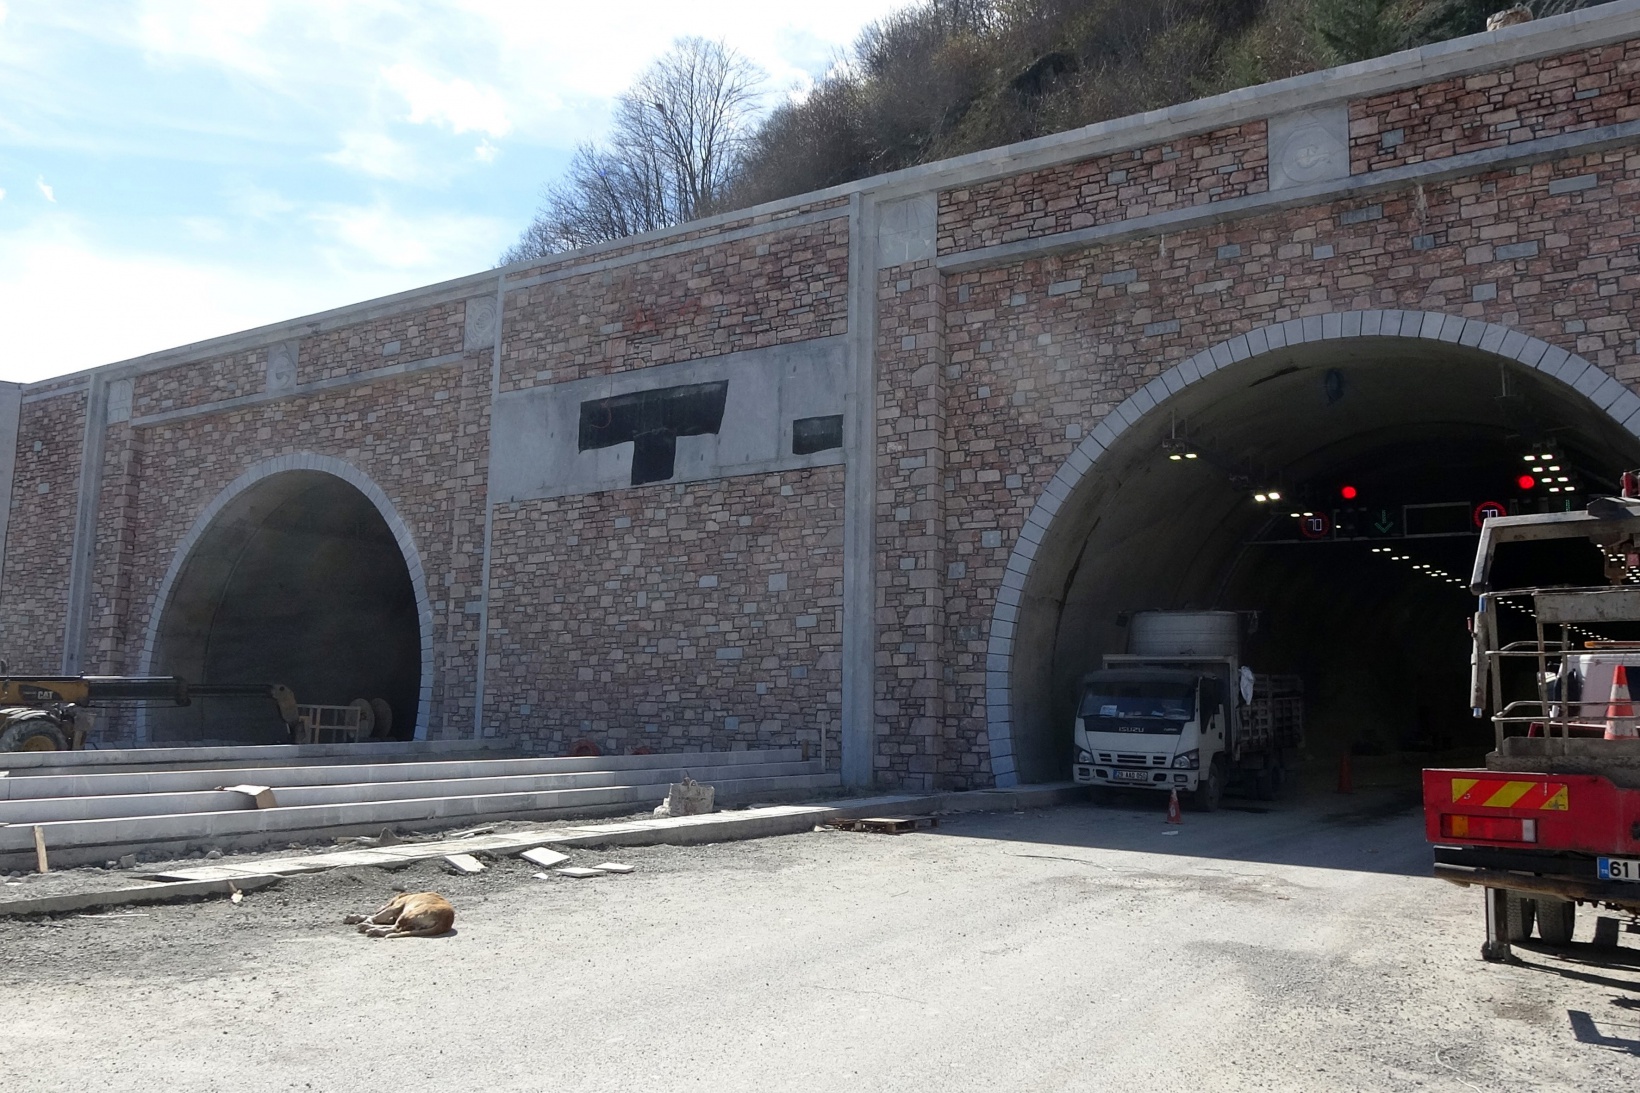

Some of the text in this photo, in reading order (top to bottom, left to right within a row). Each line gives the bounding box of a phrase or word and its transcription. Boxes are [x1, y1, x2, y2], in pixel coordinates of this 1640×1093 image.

[1307, 518, 1322, 531] 70
[37, 691, 53, 700] CAT
[1610, 861, 1629, 878] 61
